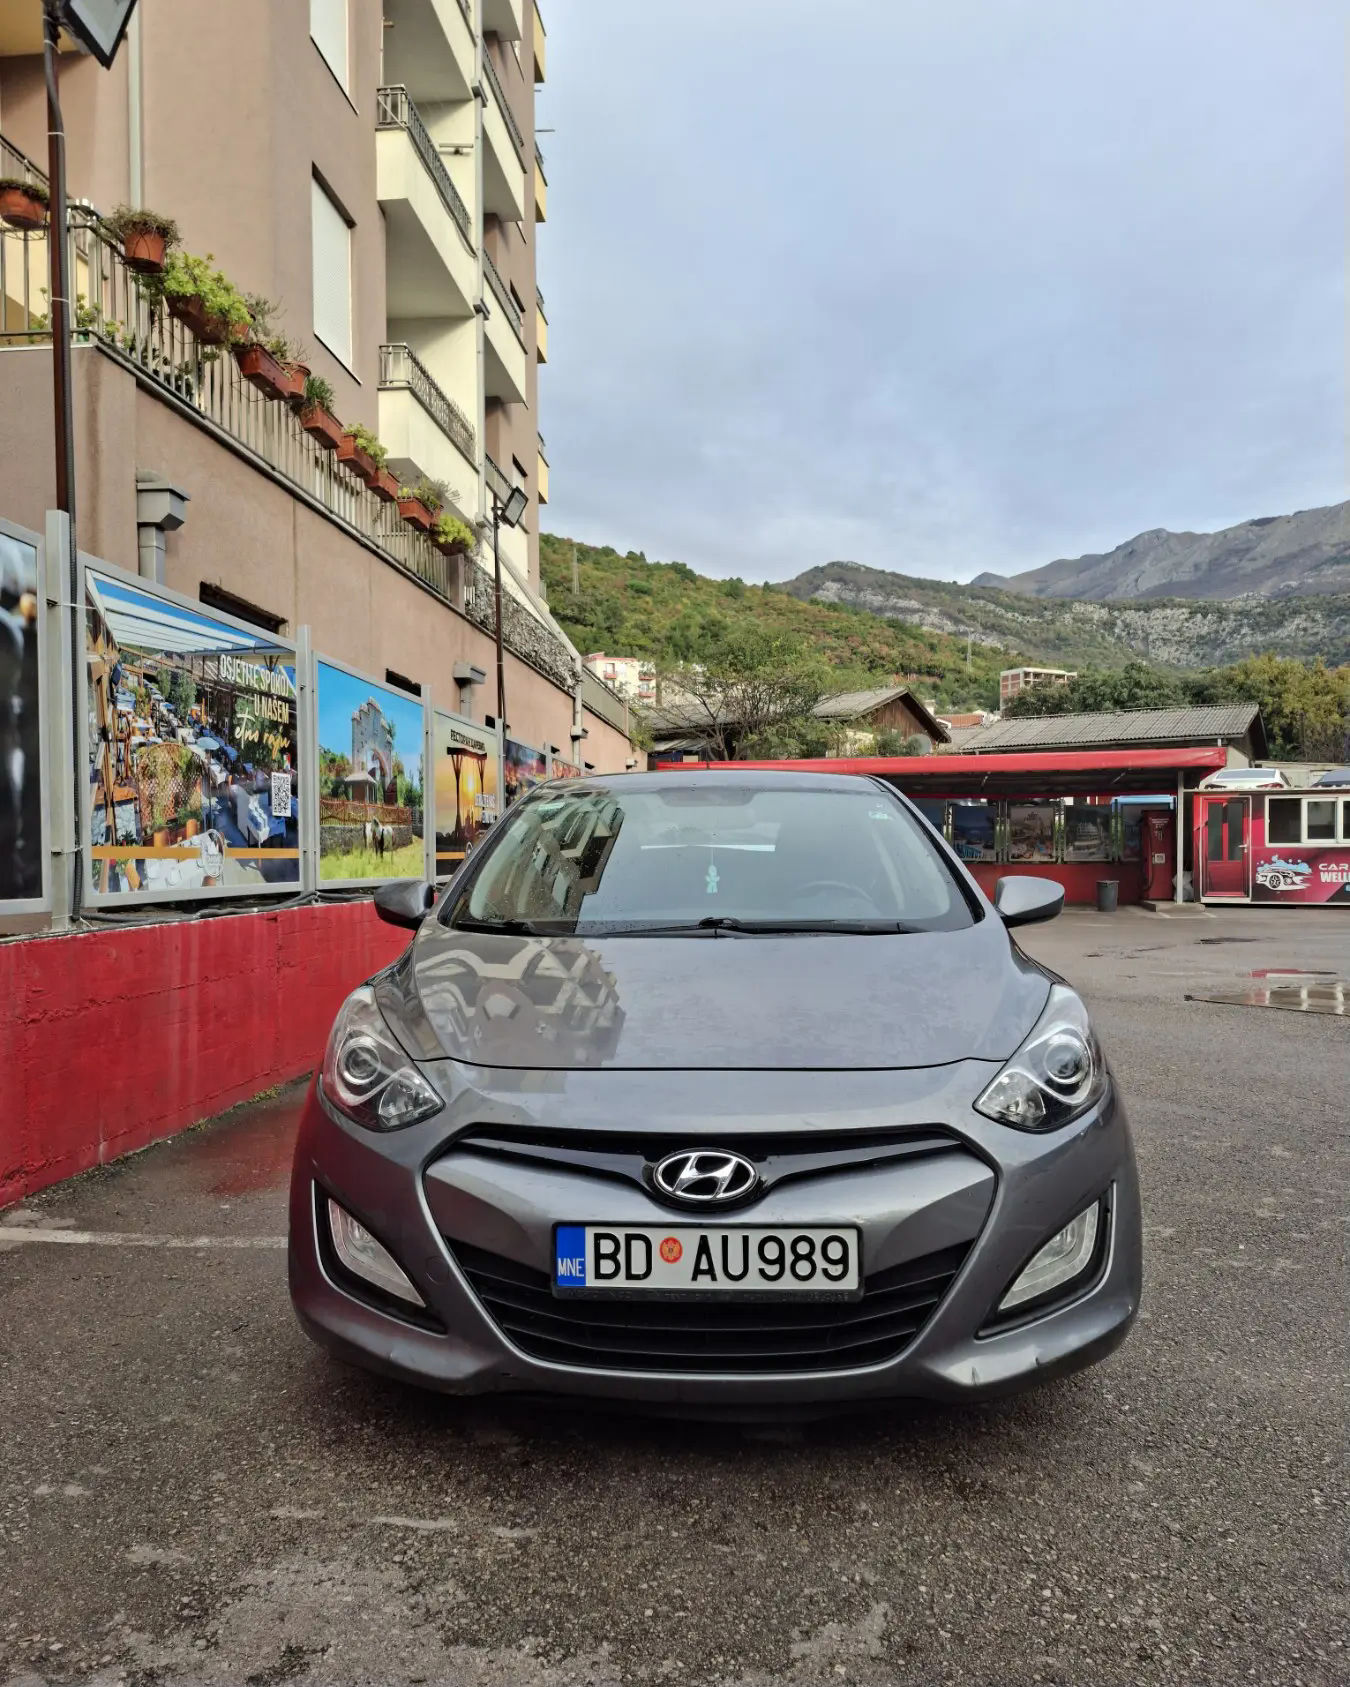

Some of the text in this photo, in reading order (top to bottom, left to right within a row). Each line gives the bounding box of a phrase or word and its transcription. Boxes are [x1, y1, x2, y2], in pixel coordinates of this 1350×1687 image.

[260, 671, 289, 697] SPOKOJ
[254, 693, 289, 724] U NAŠEM
[1318, 863, 1349, 871] CAR
[1320, 871, 1350, 883] WELL
[557, 1257, 584, 1277] MNE
[593, 1232, 850, 1282] BD AU989
